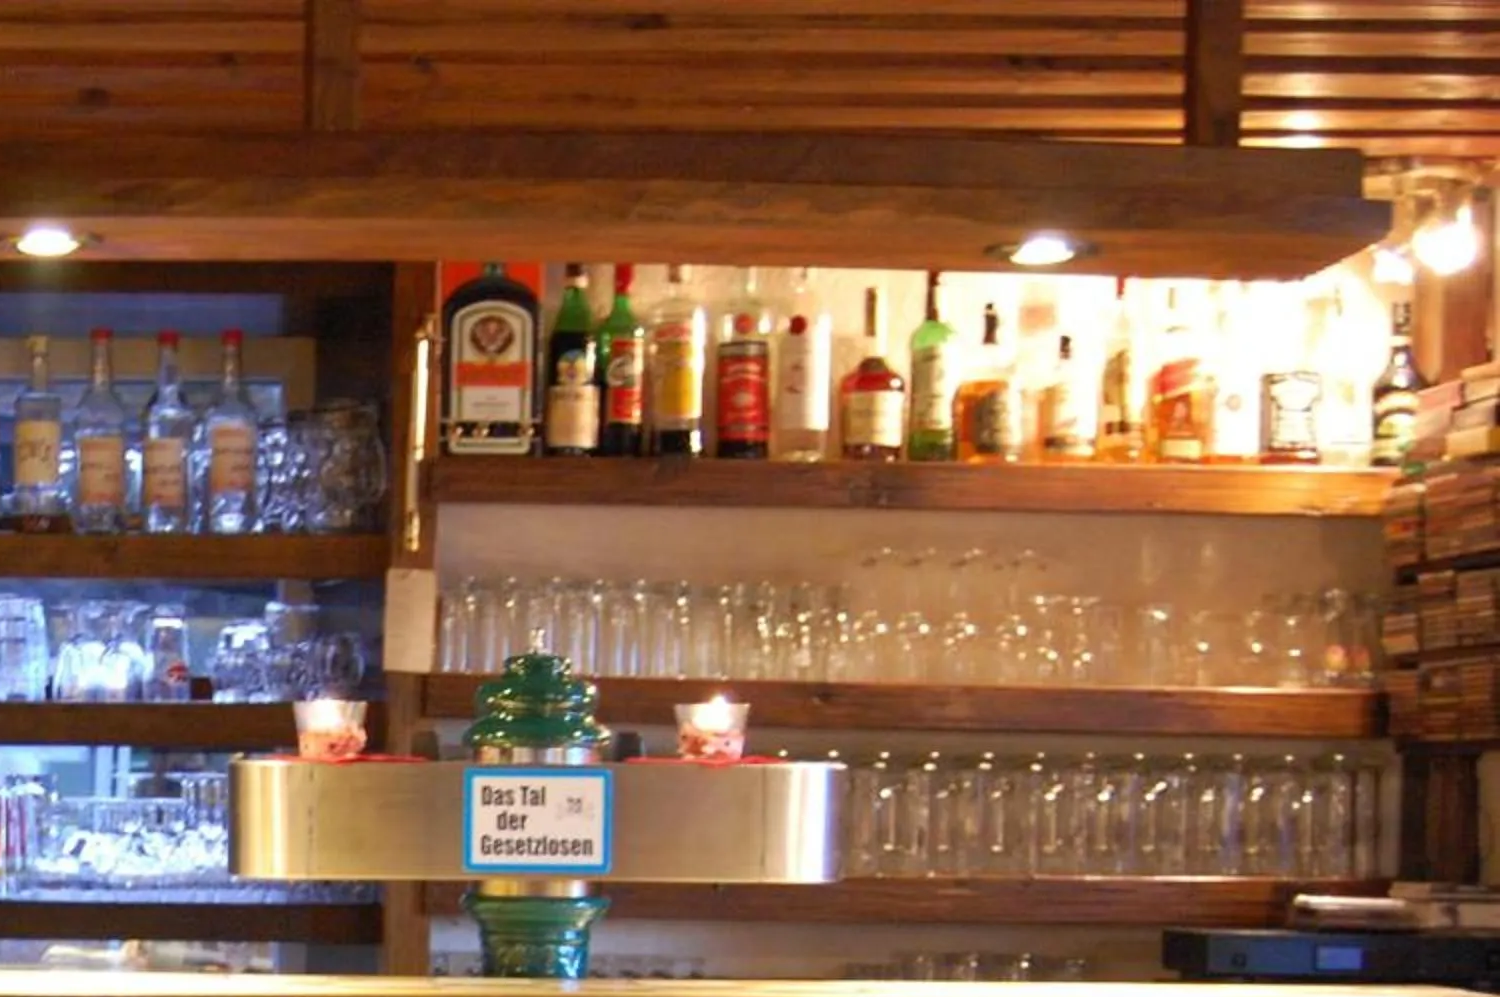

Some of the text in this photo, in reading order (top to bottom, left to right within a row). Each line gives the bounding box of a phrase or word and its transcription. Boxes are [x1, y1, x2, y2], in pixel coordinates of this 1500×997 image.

[481, 785, 547, 806] Das Tal
[496, 811, 529, 831] der
[480, 834, 593, 857] Gesetzlosen
